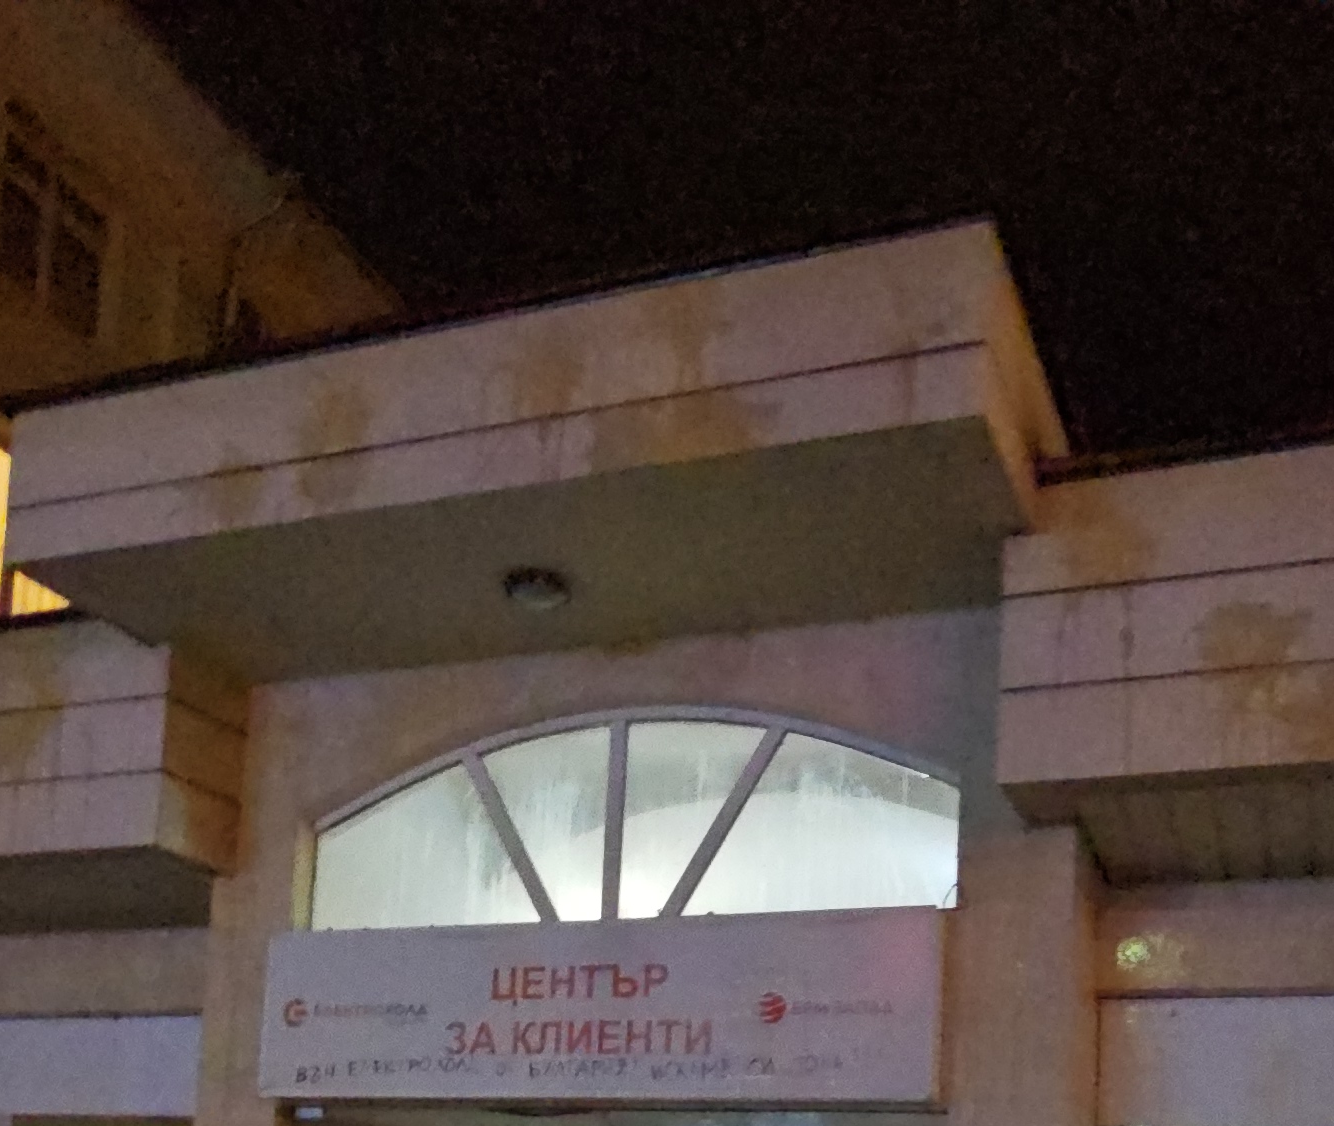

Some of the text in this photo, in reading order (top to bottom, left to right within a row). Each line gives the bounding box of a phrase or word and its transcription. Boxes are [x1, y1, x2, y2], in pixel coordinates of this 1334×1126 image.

[491, 964, 669, 1006] ЦЕНТЪР
[445, 1018, 713, 1055] ЗА КЛИЕНТИ
